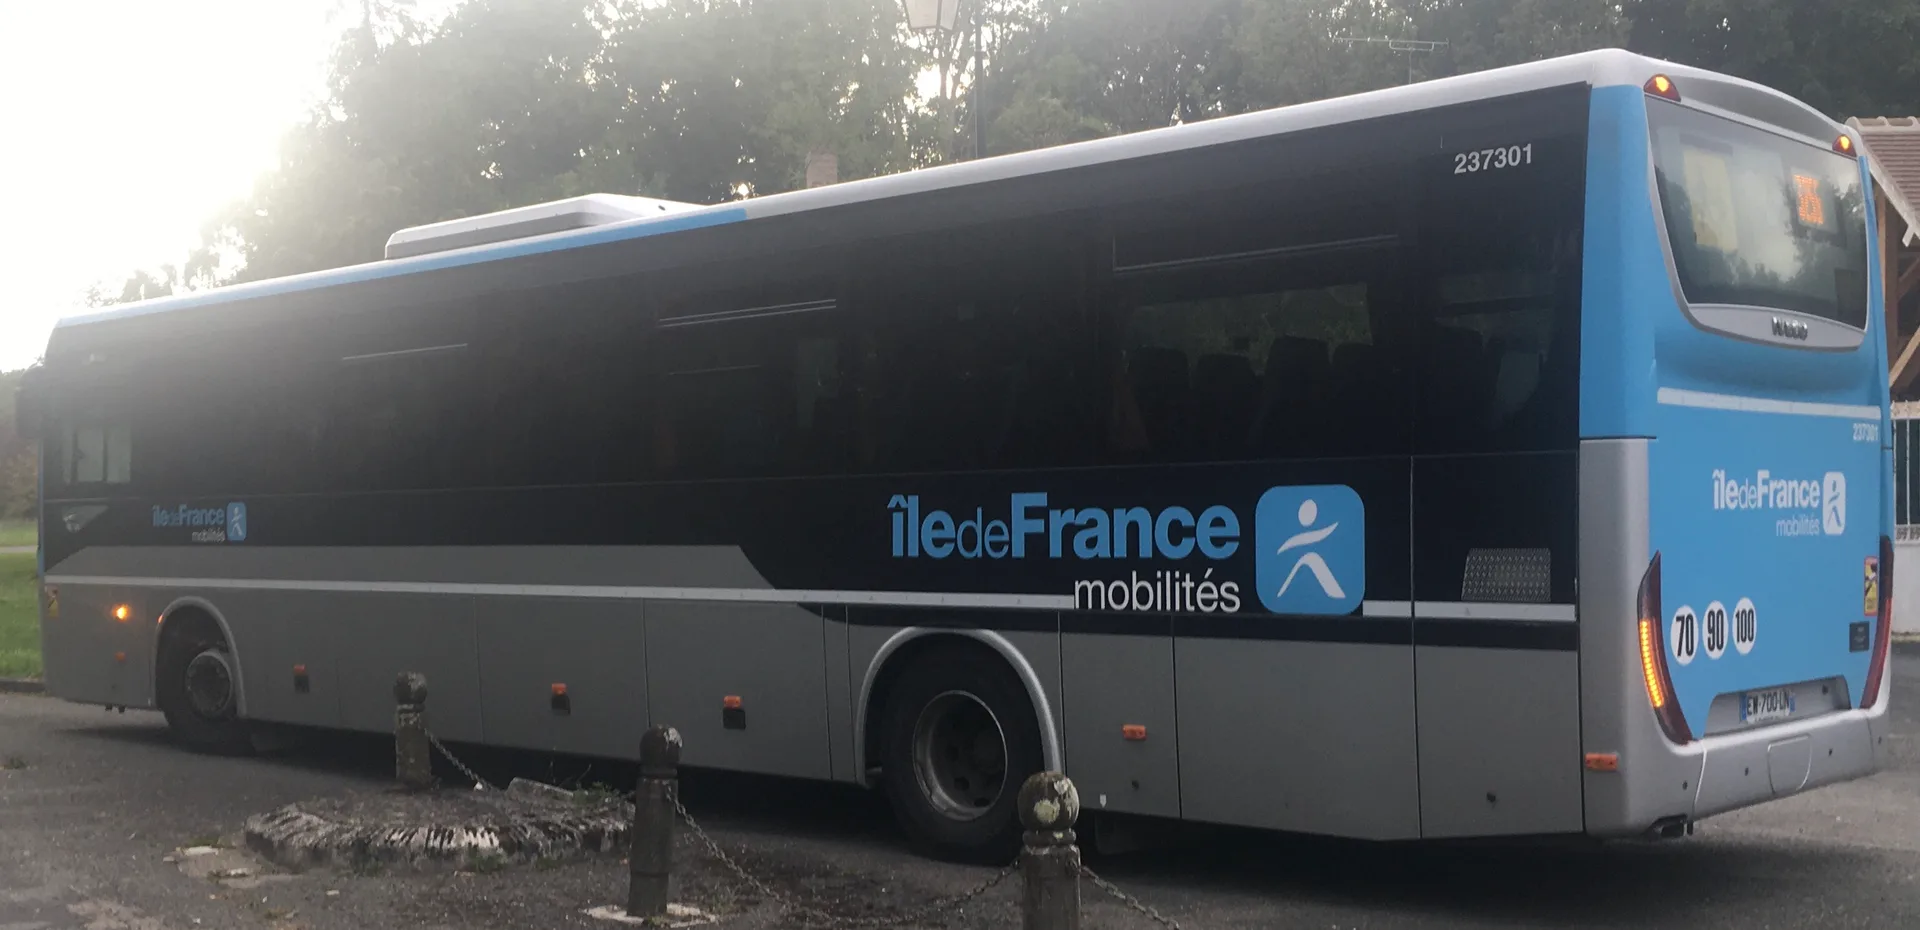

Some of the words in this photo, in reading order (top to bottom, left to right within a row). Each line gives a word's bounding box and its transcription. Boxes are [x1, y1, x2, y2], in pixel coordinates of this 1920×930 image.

[1454, 143, 1532, 174] 237301
[1775, 513, 1820, 537] mobilités
[1074, 568, 1241, 613] mobilités
[1675, 613, 1694, 657] 70
[1707, 609, 1724, 652] 90
[1735, 608, 1755, 643] 100
